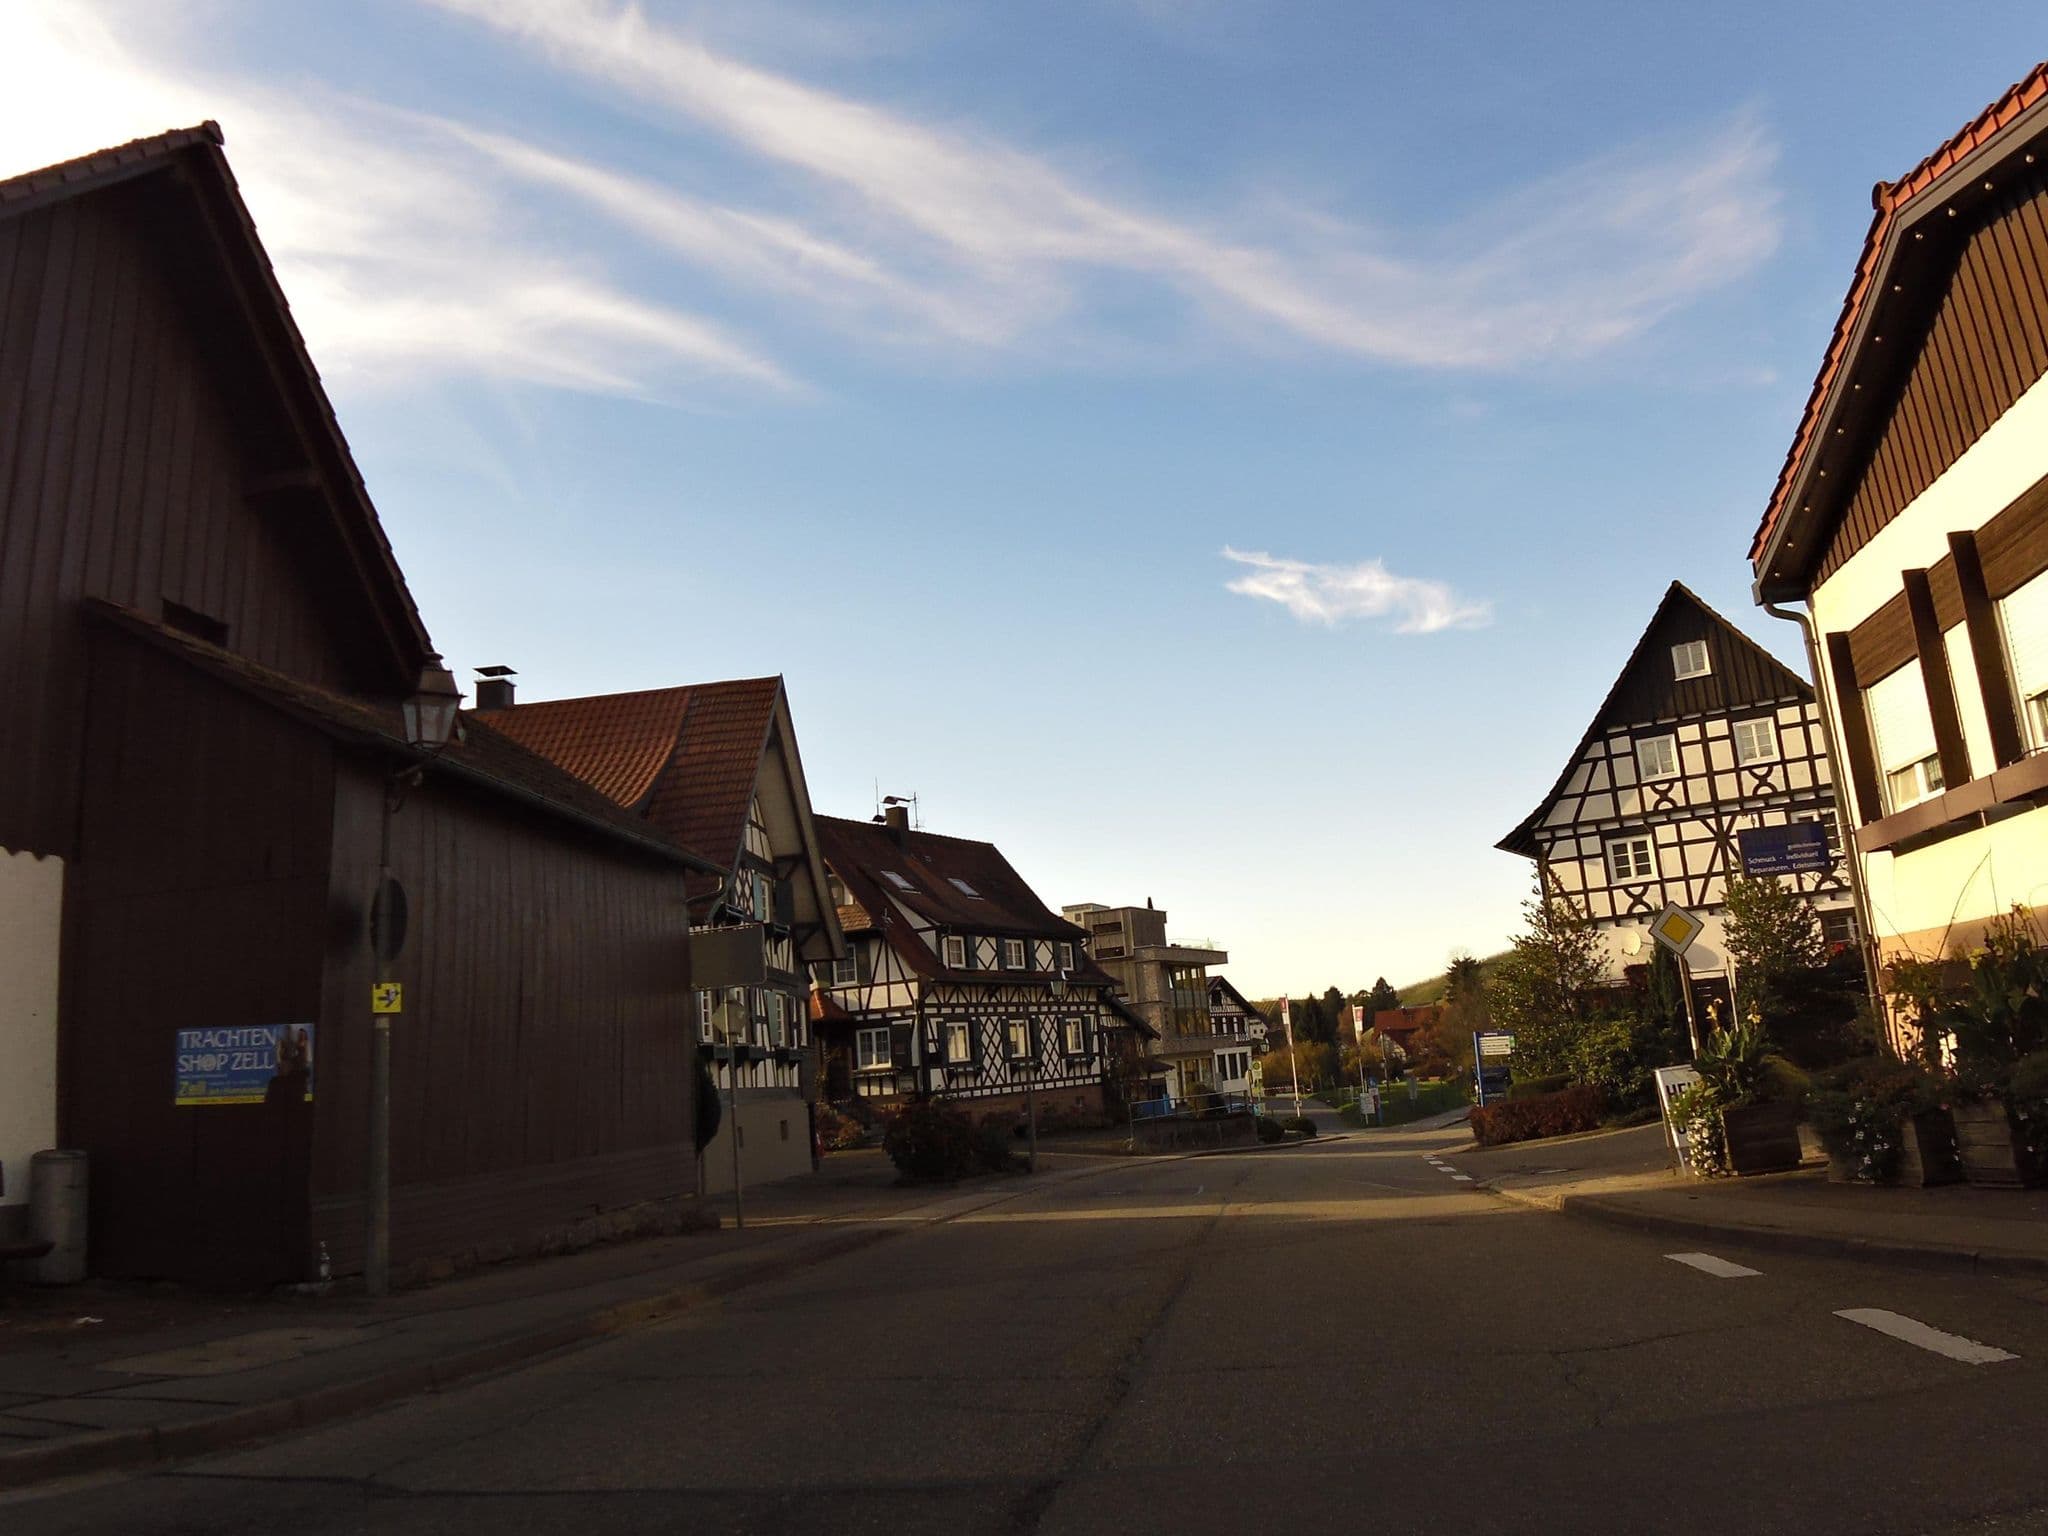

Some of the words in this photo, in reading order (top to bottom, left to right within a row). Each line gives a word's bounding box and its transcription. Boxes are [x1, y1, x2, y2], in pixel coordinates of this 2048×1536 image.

[178, 1028, 276, 1049] TRACHTEN
[177, 1054, 228, 1072] SHOP
[231, 1051, 275, 1070] ZELL
